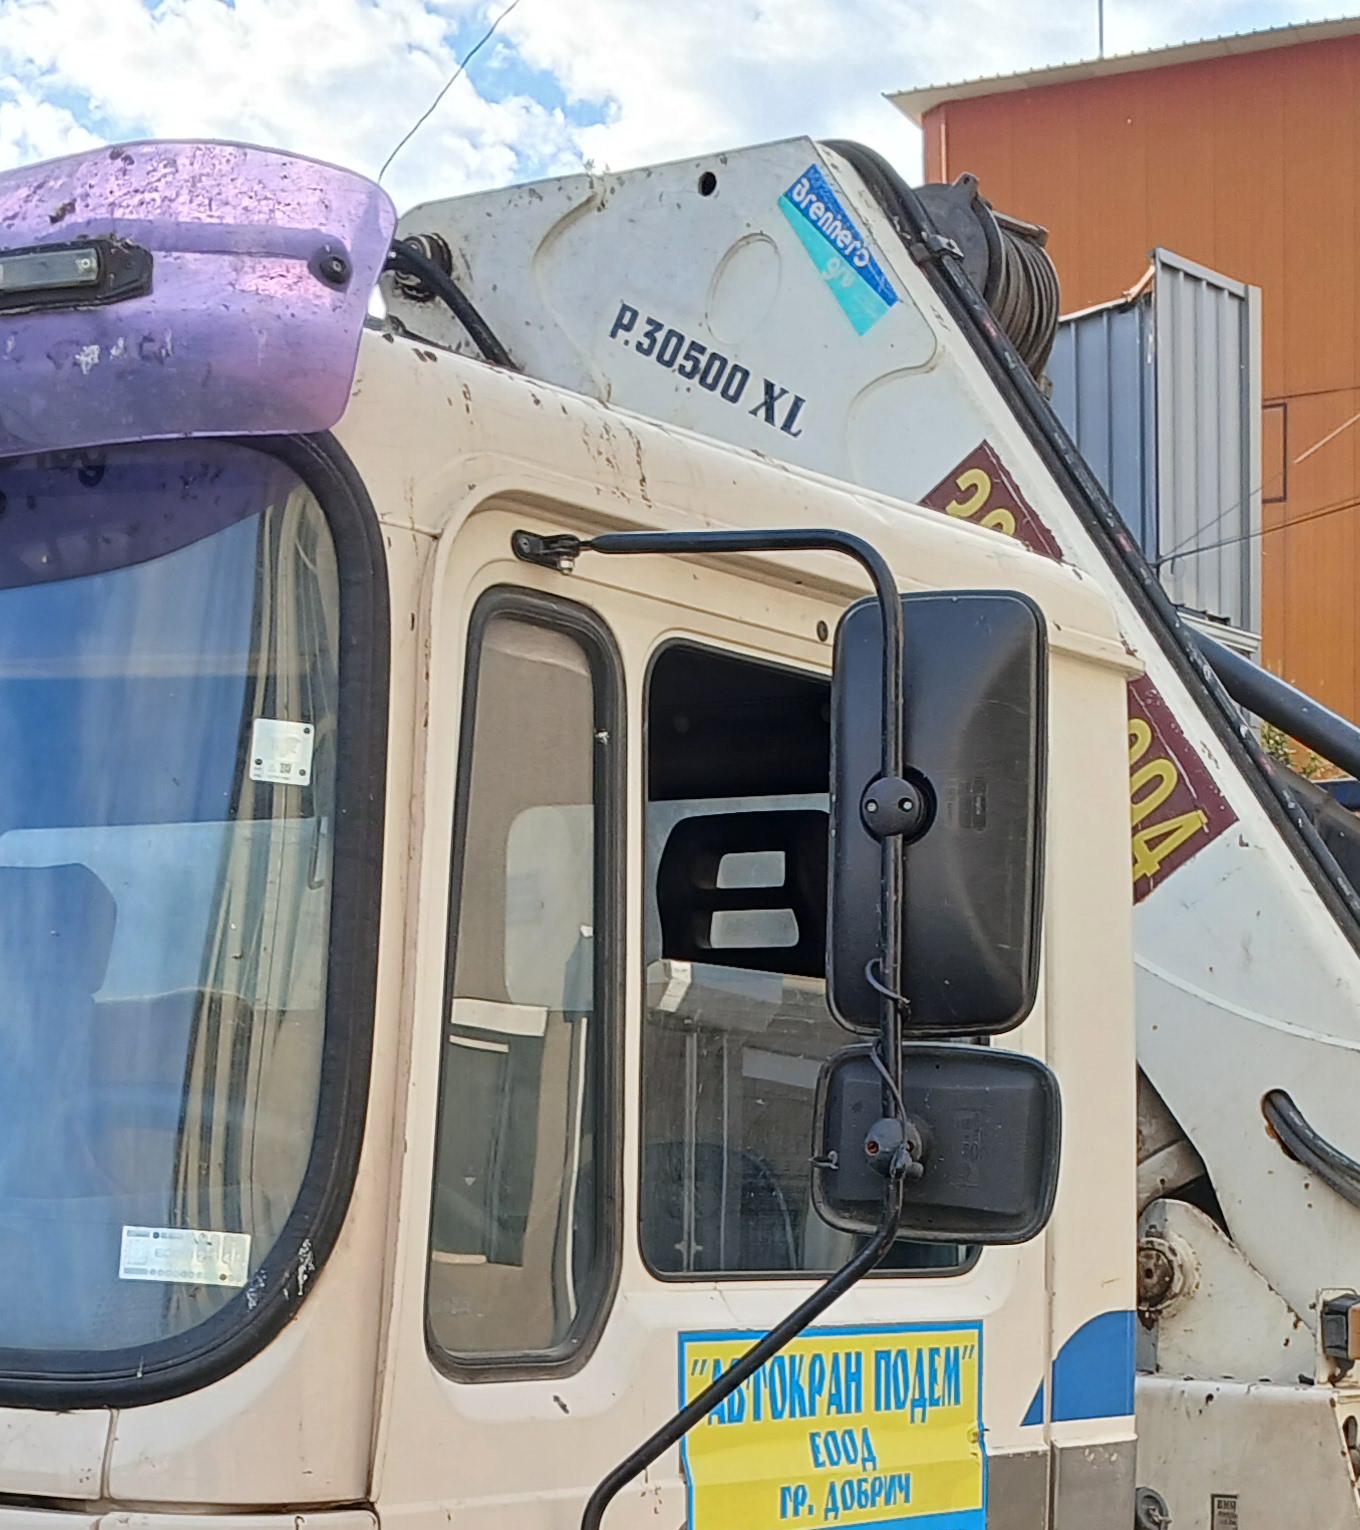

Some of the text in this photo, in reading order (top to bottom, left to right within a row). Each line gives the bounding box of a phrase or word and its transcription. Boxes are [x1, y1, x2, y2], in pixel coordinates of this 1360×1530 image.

[609, 302, 806, 439] P.30500 XL
[808, 1427, 878, 1472] ЕООД
[779, 1473, 912, 1521] ГР. ДОБРИЧ
